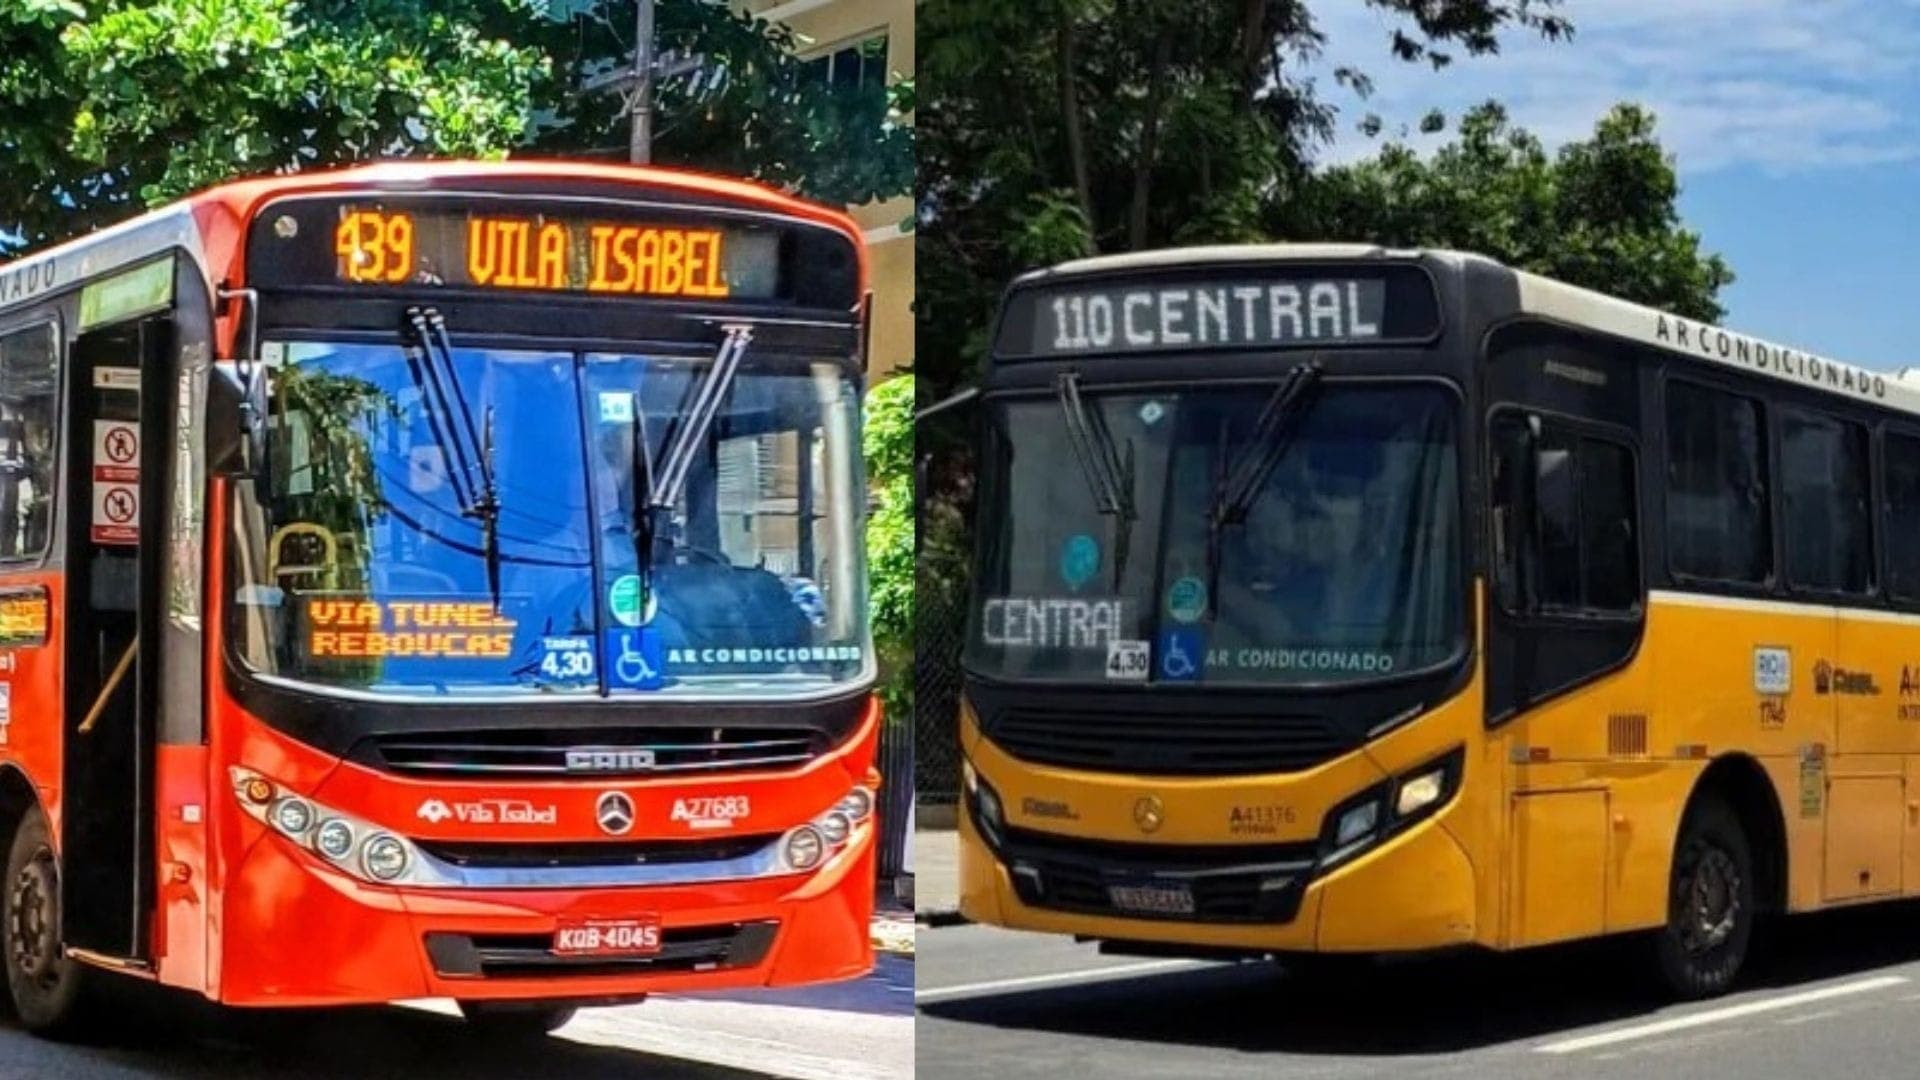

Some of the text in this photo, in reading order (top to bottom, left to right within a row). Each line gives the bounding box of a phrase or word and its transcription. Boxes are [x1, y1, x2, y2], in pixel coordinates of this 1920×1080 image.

[337, 211, 730, 297] 439 VILA ISABEL
[1052, 281, 1378, 349] 110 CENTRAL
[1656, 314, 1886, 398] AR CONDICIONADO
[309, 600, 383, 626] VIA
[312, 632, 514, 656] REBOUCAS
[668, 647, 862, 663] AR CONDICIONADO
[541, 651, 593, 679] 4,30
[1206, 649, 1394, 672] AR CONDICIONADO
[453, 799, 556, 824] Vila Isabel
[670, 796, 750, 821] A27683
